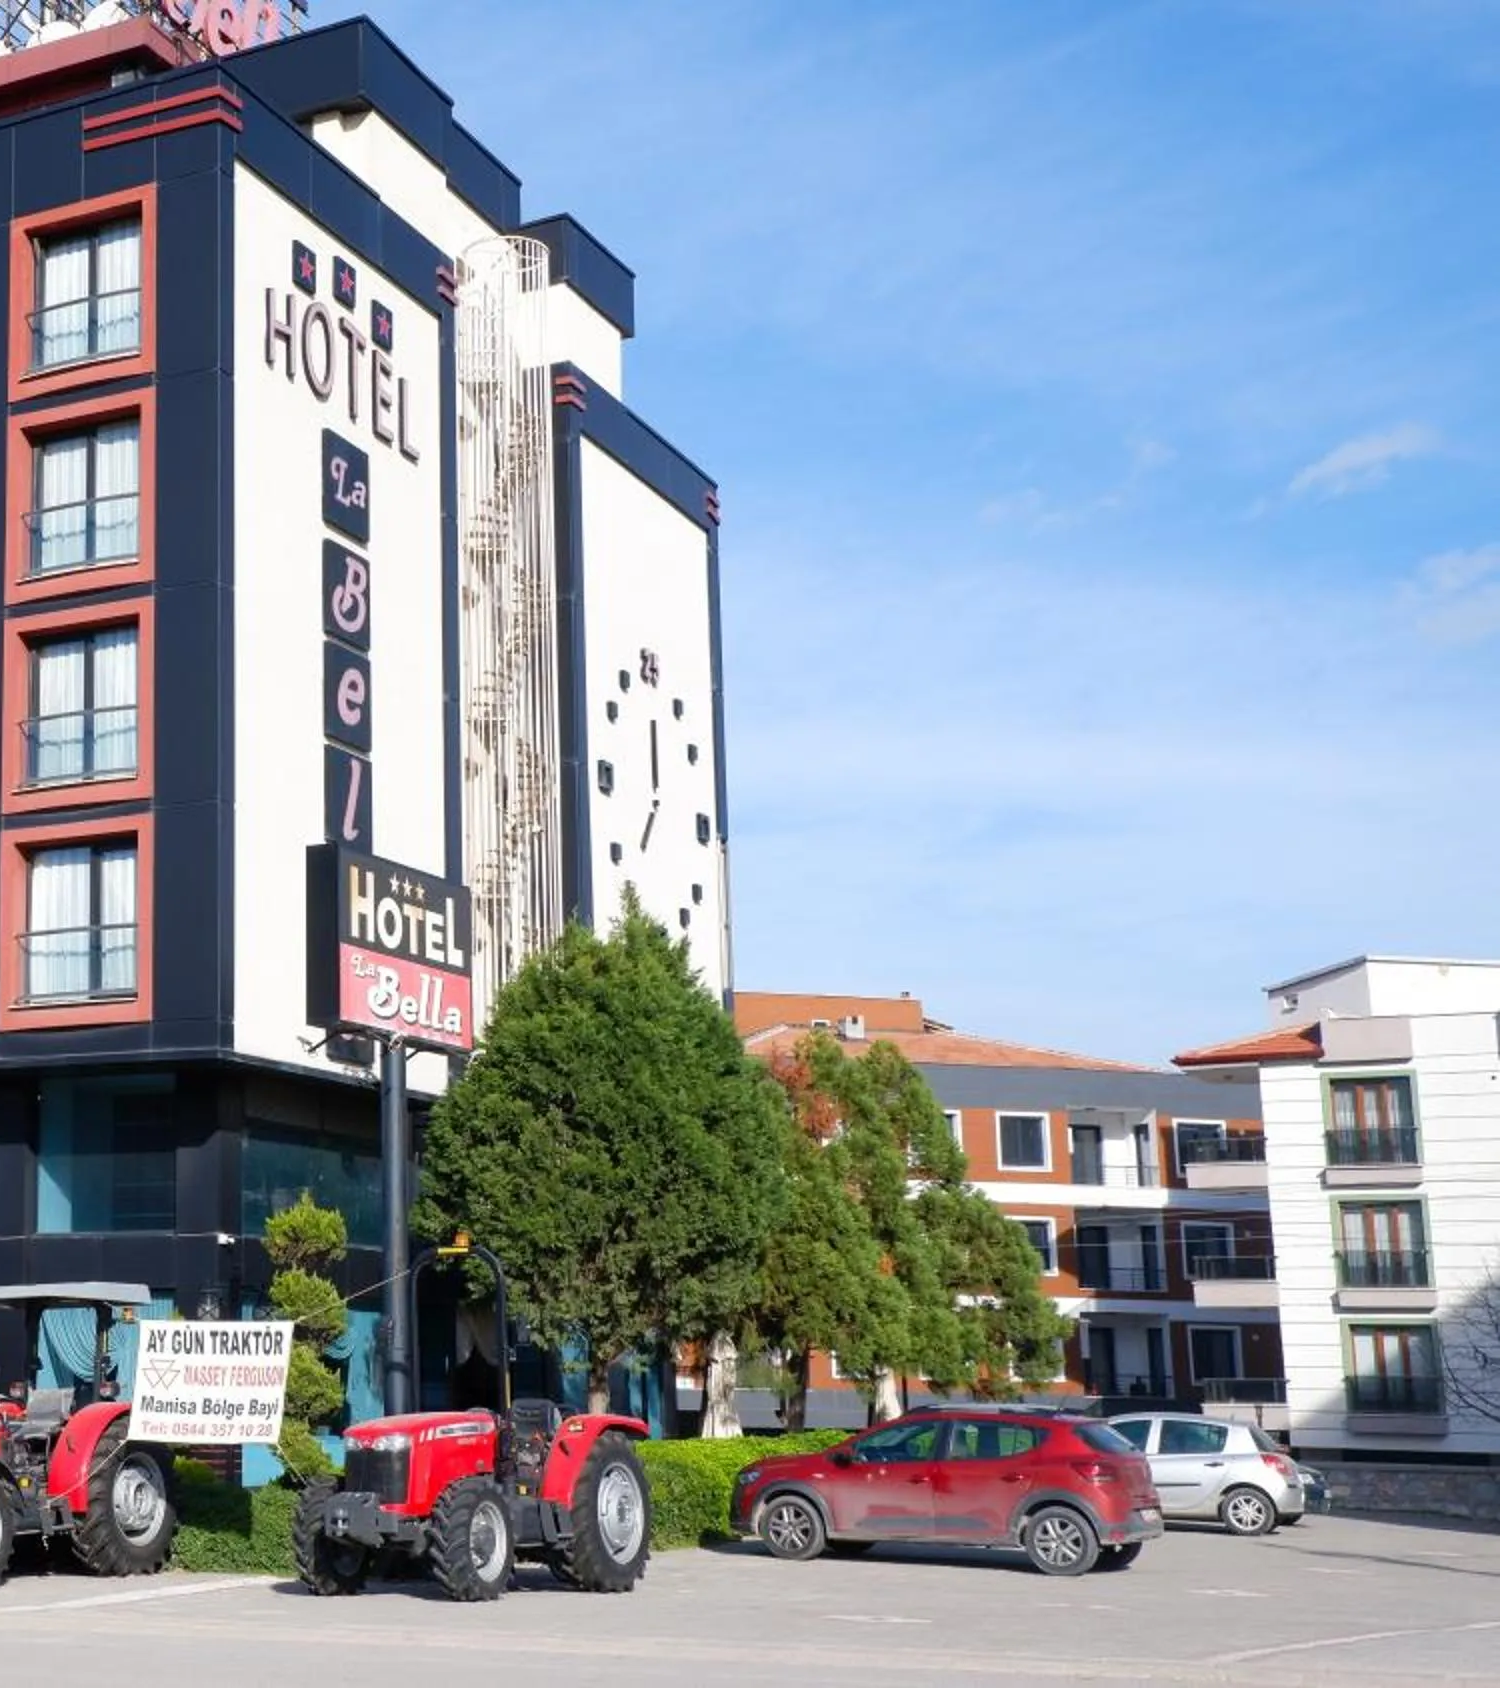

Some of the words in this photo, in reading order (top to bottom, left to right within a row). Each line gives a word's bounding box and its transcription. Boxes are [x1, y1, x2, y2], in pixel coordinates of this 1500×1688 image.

[265, 286, 420, 466] HOTEL
[330, 456, 366, 510] La
[350, 865, 466, 968] HOTEL
[351, 954, 375, 978] La
[367, 966, 463, 1035] Bella
[146, 1329, 167, 1353] AY
[171, 1325, 205, 1355] GÜN
[209, 1326, 284, 1356] TRAKTÖR
[183, 1365, 229, 1387] MASSEY
[230, 1366, 285, 1389] FERGUSON
[140, 1395, 197, 1415] Manisa
[202, 1397, 245, 1420] Bölge
